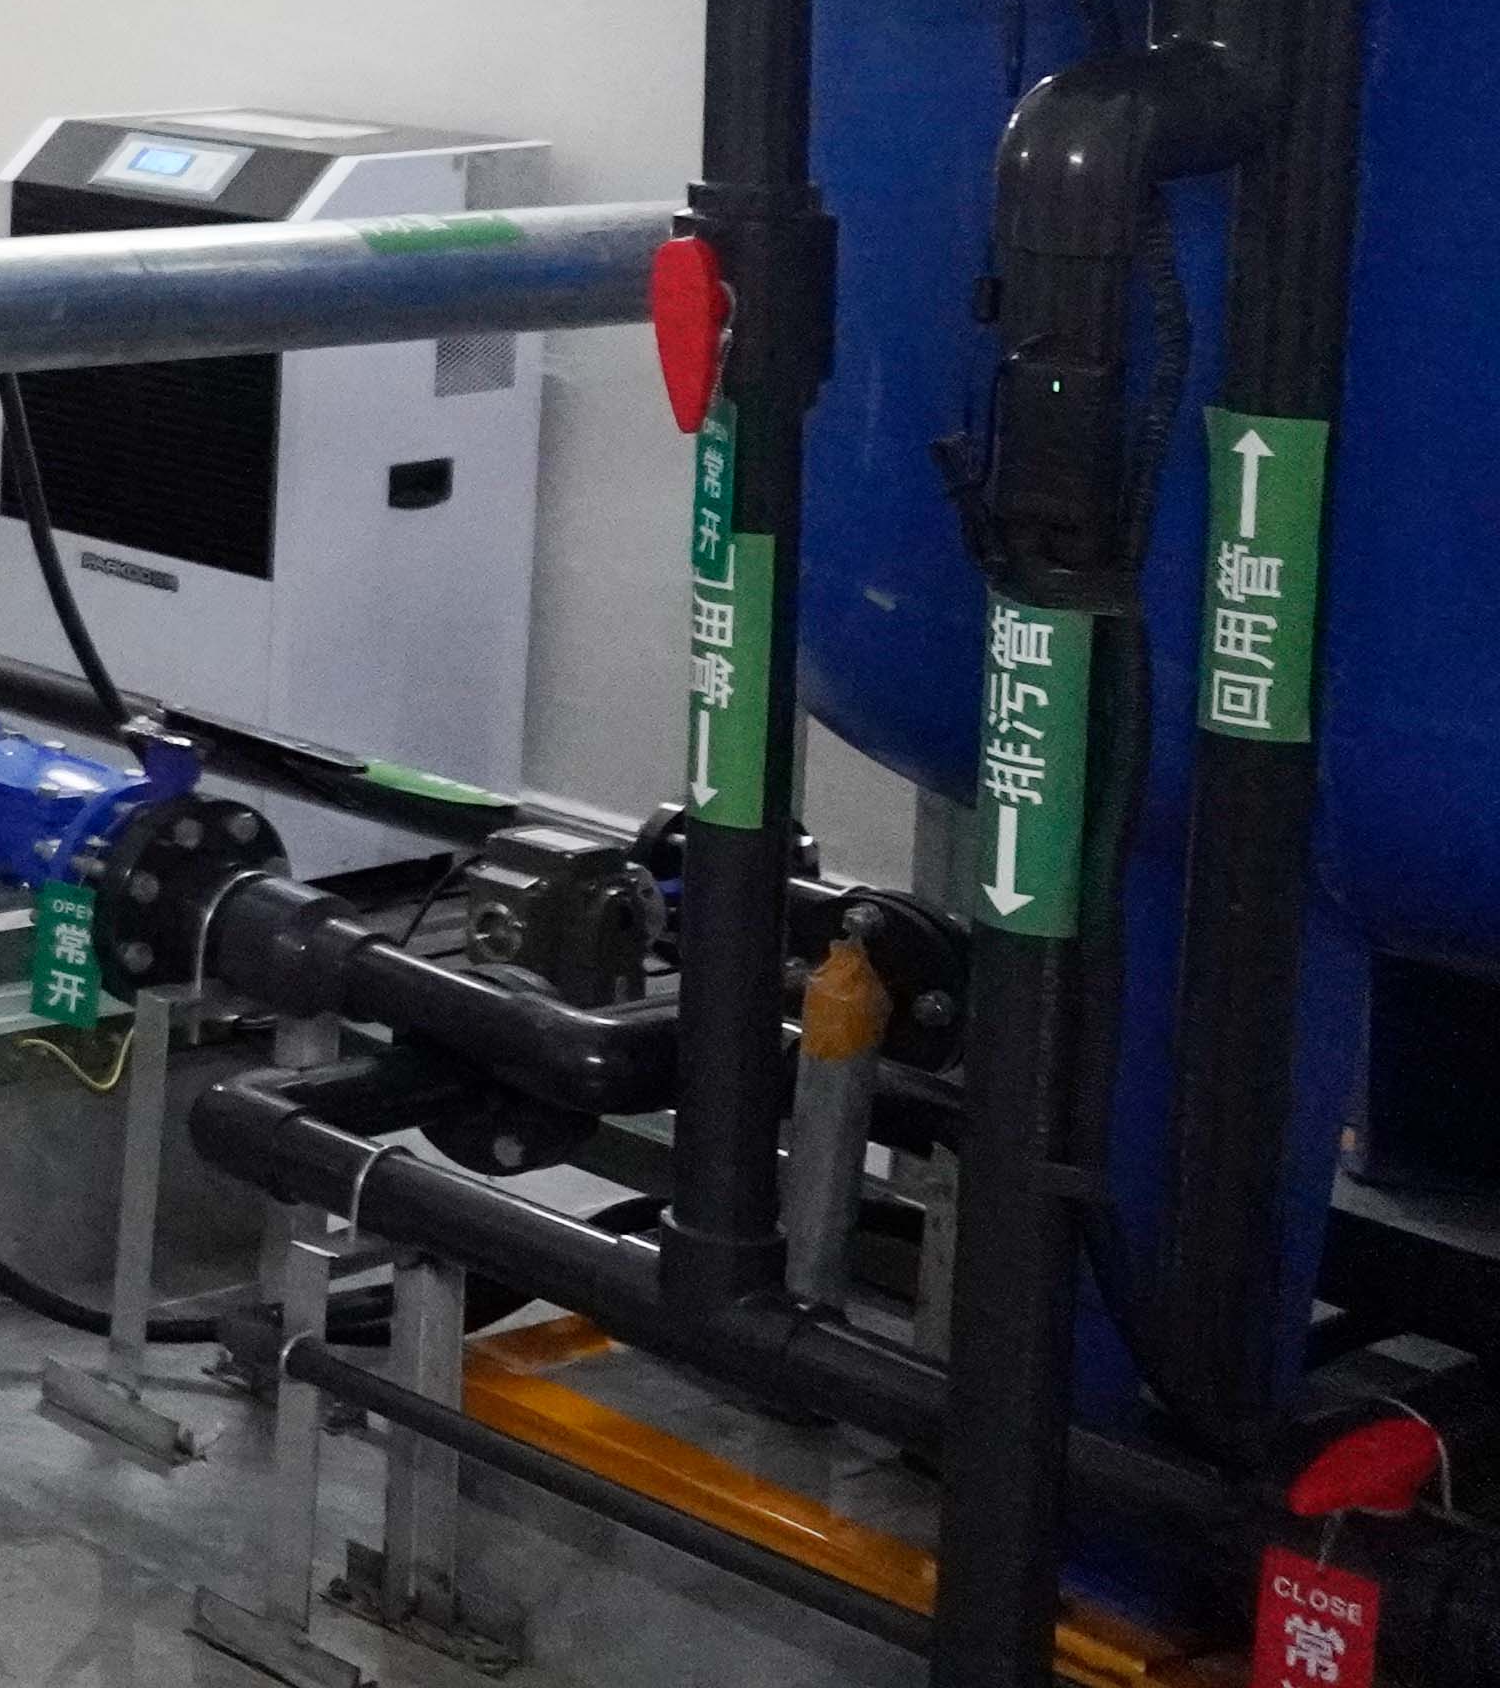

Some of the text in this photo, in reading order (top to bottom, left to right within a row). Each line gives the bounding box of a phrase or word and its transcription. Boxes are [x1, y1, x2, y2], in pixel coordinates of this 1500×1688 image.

[1212, 541, 1284, 729] 回用管
[985, 605, 1054, 805] 排污管
[48, 922, 92, 1013] 常开
[1273, 1575, 1362, 1627] CLOSE
[1281, 1613, 1346, 1688] 常
